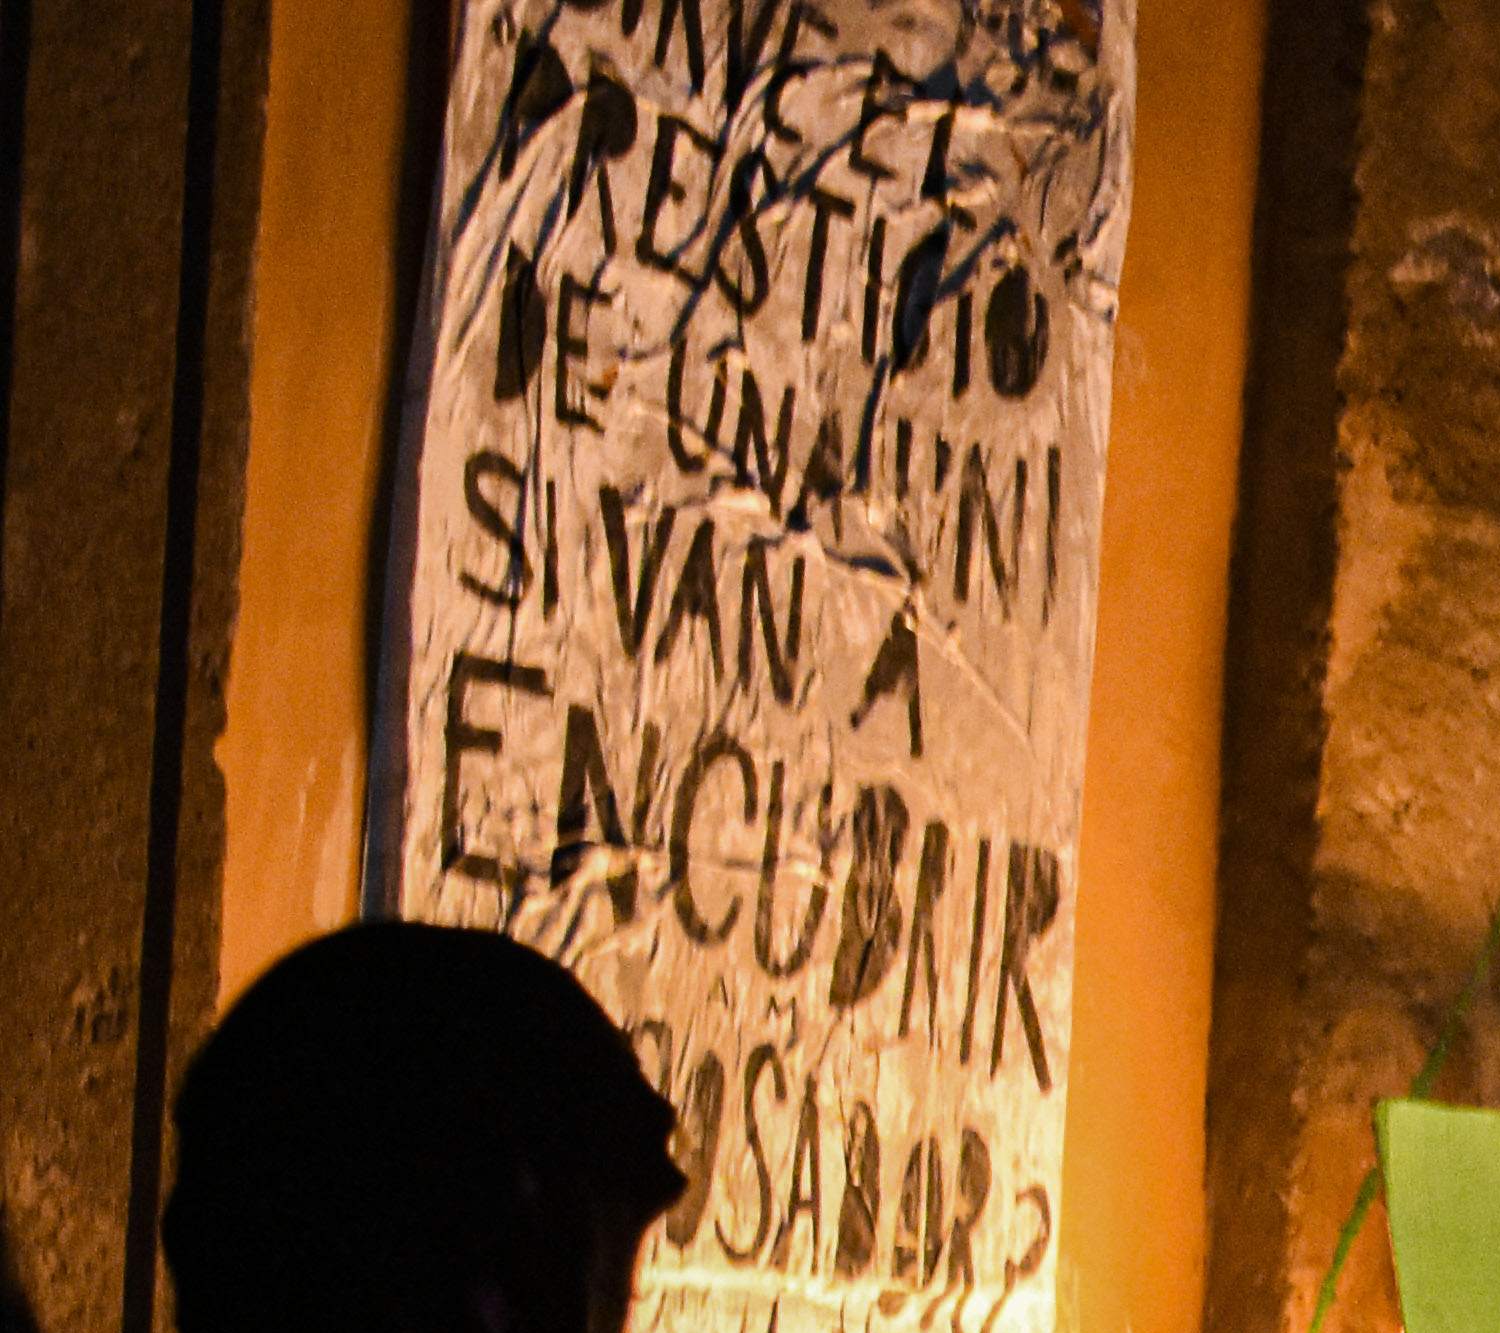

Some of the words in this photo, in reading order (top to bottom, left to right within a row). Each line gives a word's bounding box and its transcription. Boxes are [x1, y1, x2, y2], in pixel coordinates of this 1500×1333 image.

[494, 240, 606, 436] DE
[458, 448, 558, 622] SI
[600, 484, 806, 706] VAN
[850, 598, 922, 758] A
[438, 652, 1054, 1094] ENCUBRIR
